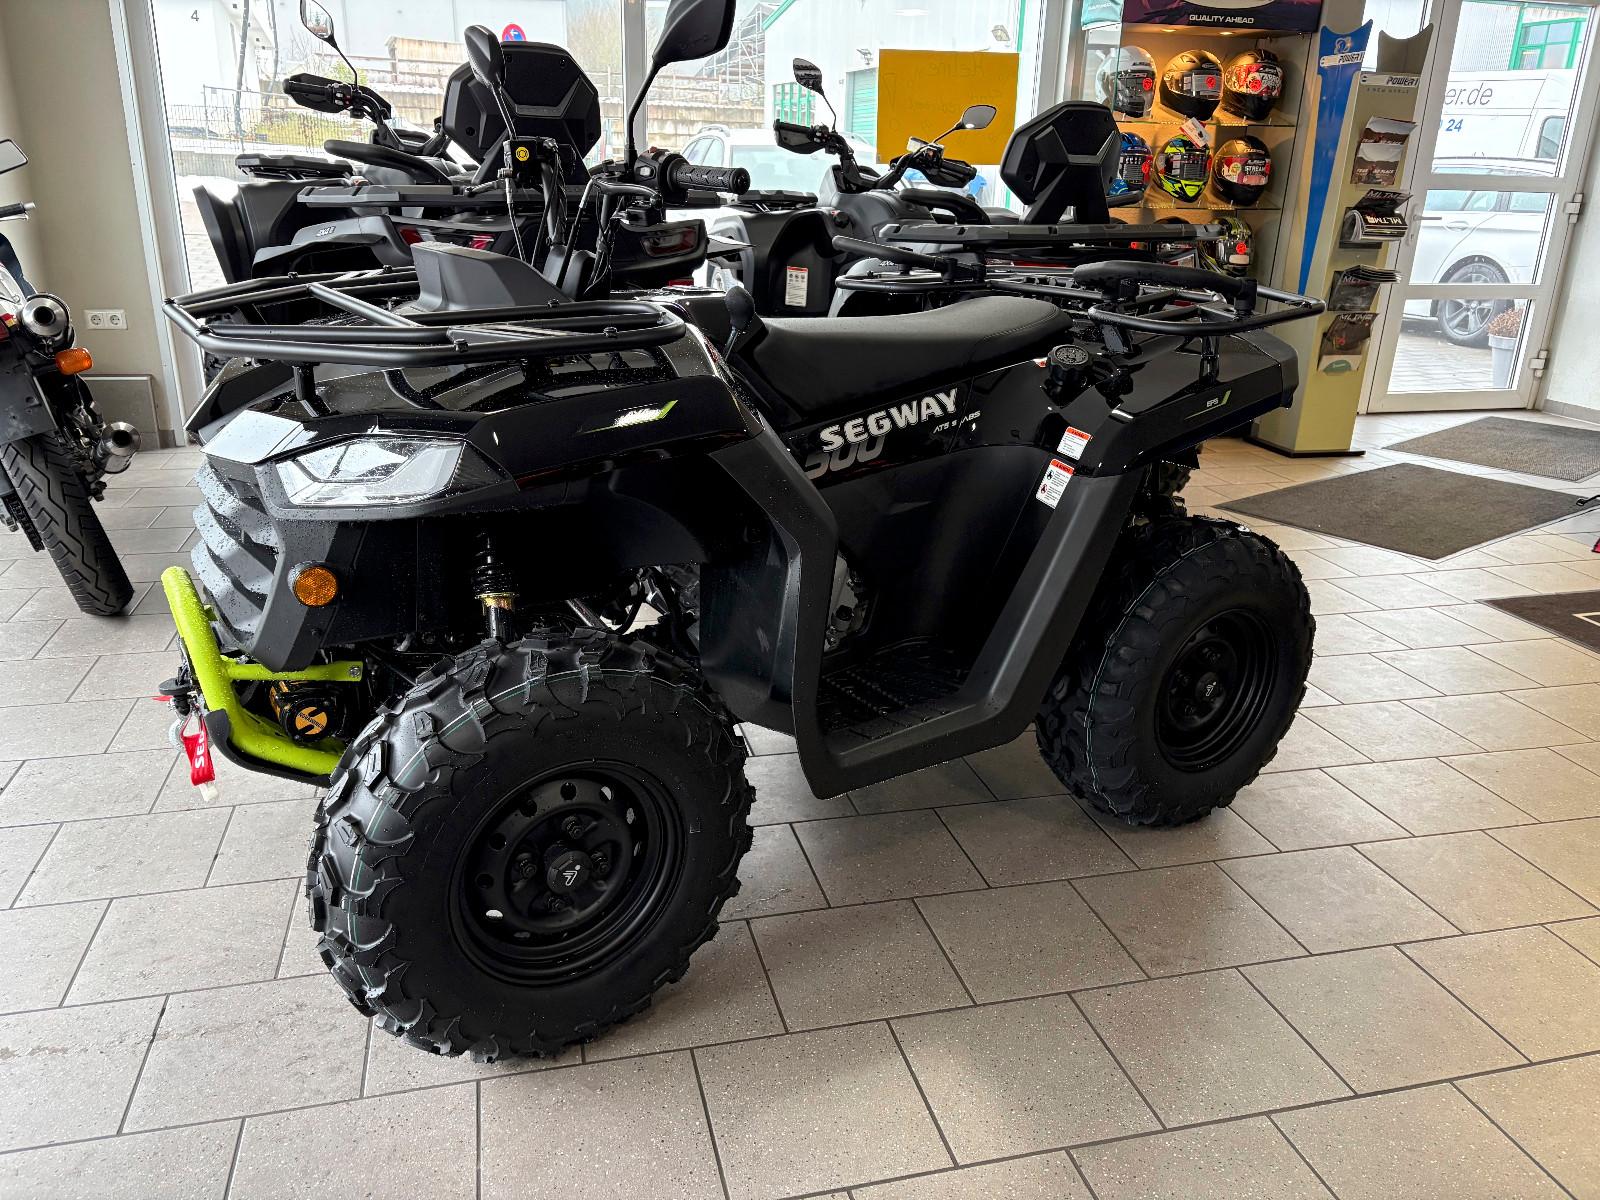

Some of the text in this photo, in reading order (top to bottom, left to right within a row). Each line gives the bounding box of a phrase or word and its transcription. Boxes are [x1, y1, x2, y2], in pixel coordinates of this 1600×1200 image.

[190, 9, 200, 22] 4
[1189, 14, 1254, 24] QUALITY AHEAD
[1445, 118, 1464, 132] 24
[1206, 397, 1219, 408] EPS
[820, 387, 958, 452] SEGWAY
